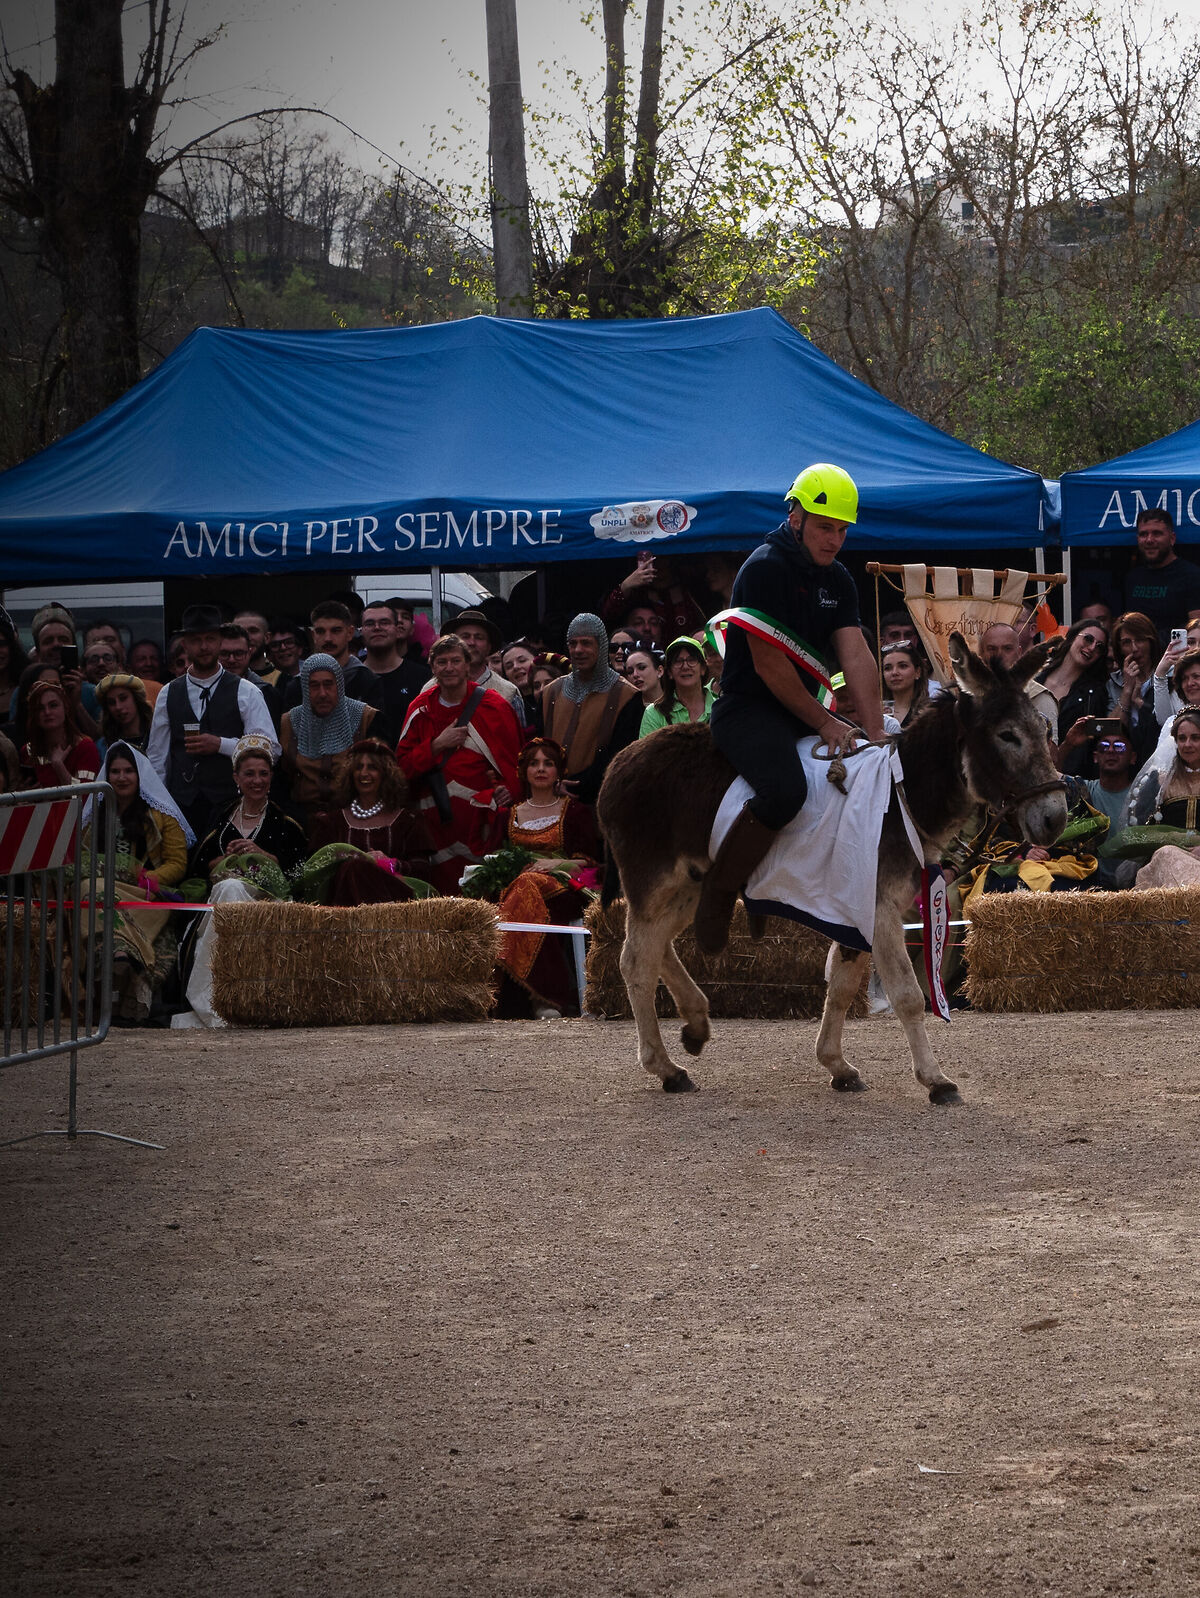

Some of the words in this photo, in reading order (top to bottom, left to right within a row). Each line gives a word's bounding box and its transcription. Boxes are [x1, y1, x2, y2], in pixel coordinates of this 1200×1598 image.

[163, 520, 289, 559] AMICI
[303, 514, 385, 555] PER
[394, 508, 563, 551] SEMPRE
[601, 519, 627, 527] UNPLI
